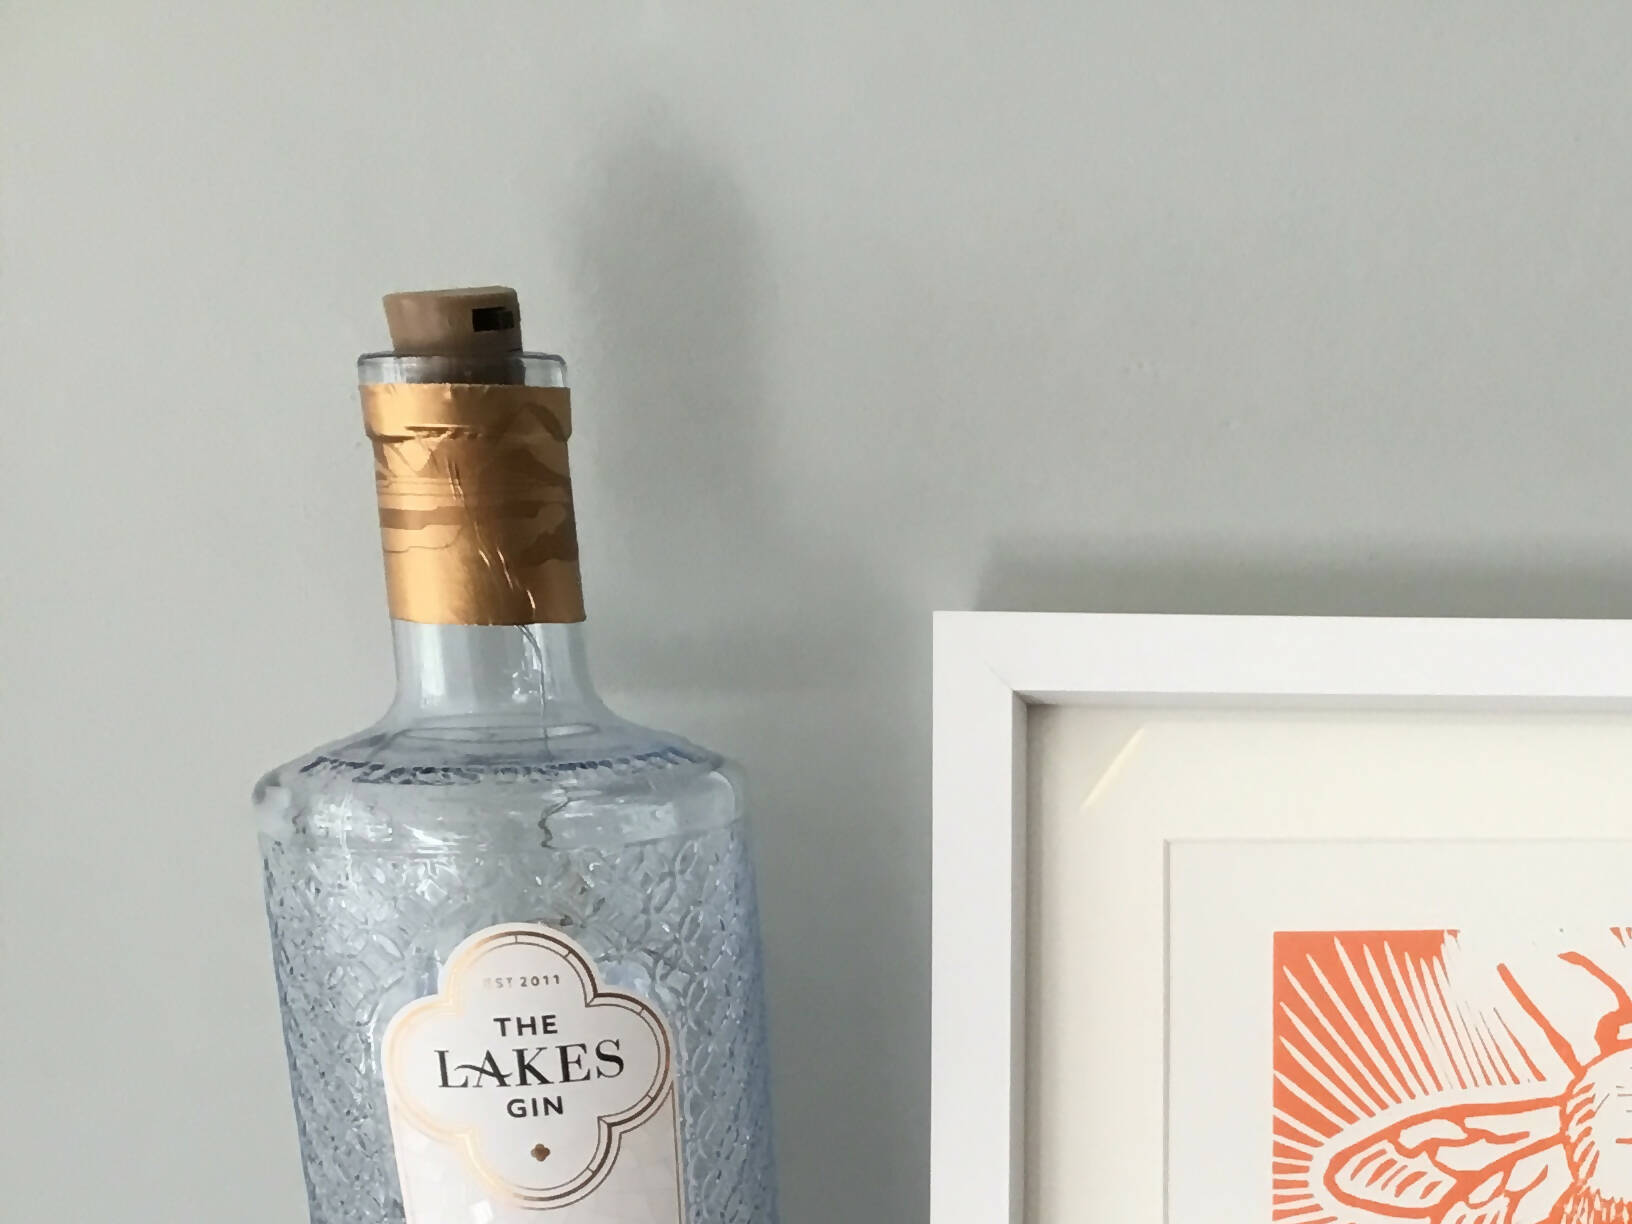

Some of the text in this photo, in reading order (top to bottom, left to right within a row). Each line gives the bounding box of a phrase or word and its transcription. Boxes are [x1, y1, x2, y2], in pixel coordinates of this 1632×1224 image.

[520, 974, 561, 988] 2011
[492, 1014, 559, 1038] THE
[434, 1038, 625, 1088] LAKES
[506, 1095, 564, 1119] GIN
